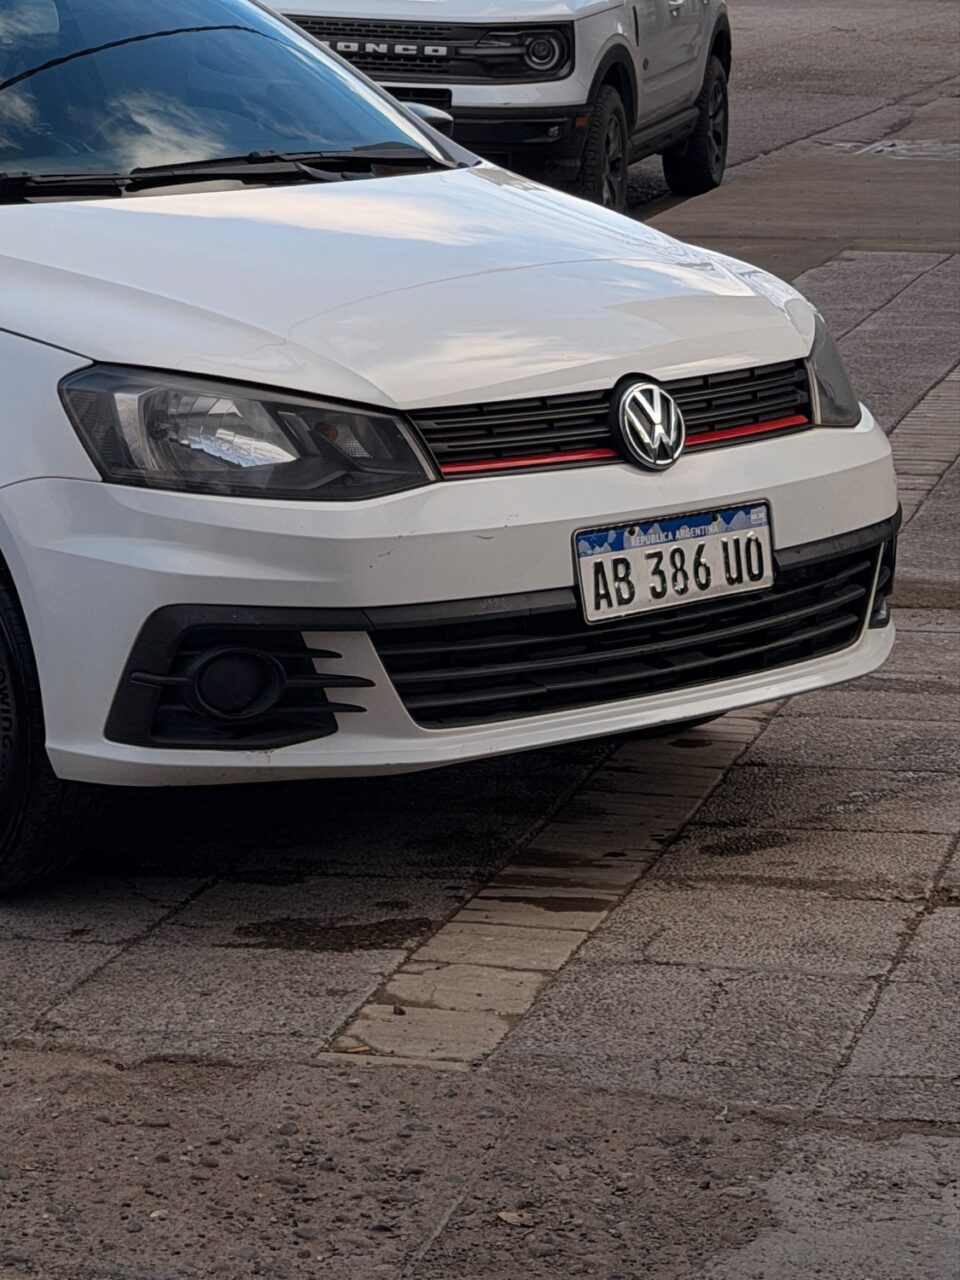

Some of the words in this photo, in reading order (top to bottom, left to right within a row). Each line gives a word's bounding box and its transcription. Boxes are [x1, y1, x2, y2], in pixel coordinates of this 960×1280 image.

[675, 523, 720, 541] ARGENTINA
[593, 555, 636, 611] AB
[644, 541, 712, 600] 386
[720, 530, 765, 586] UO
